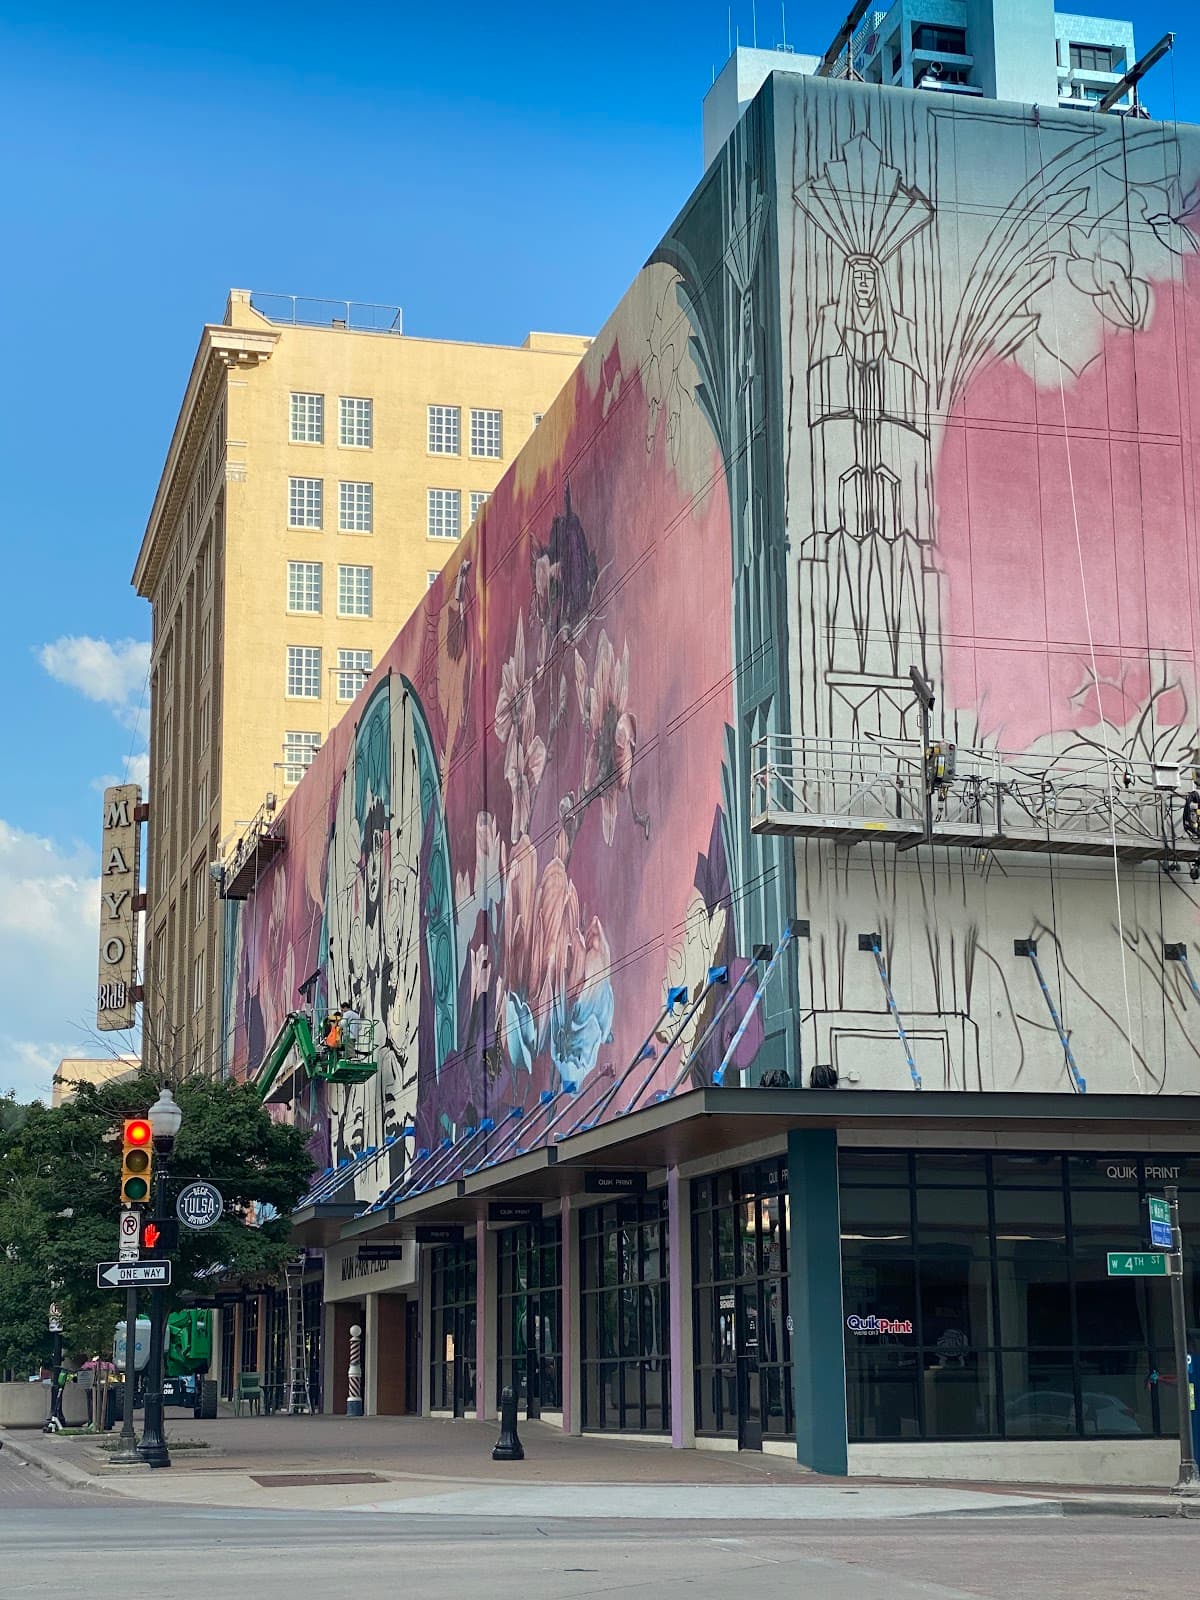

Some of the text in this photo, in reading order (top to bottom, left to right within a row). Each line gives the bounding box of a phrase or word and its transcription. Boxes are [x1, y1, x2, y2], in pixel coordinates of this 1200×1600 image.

[102, 799, 131, 966] MAYO
[98, 982, 127, 1012] Bldg
[1106, 1166, 1181, 1179] QUIK PRINT
[183, 1197, 215, 1214] TULSA
[1111, 1255, 1161, 1271] W 4TH ST
[120, 1268, 161, 1279] ONE WAY
